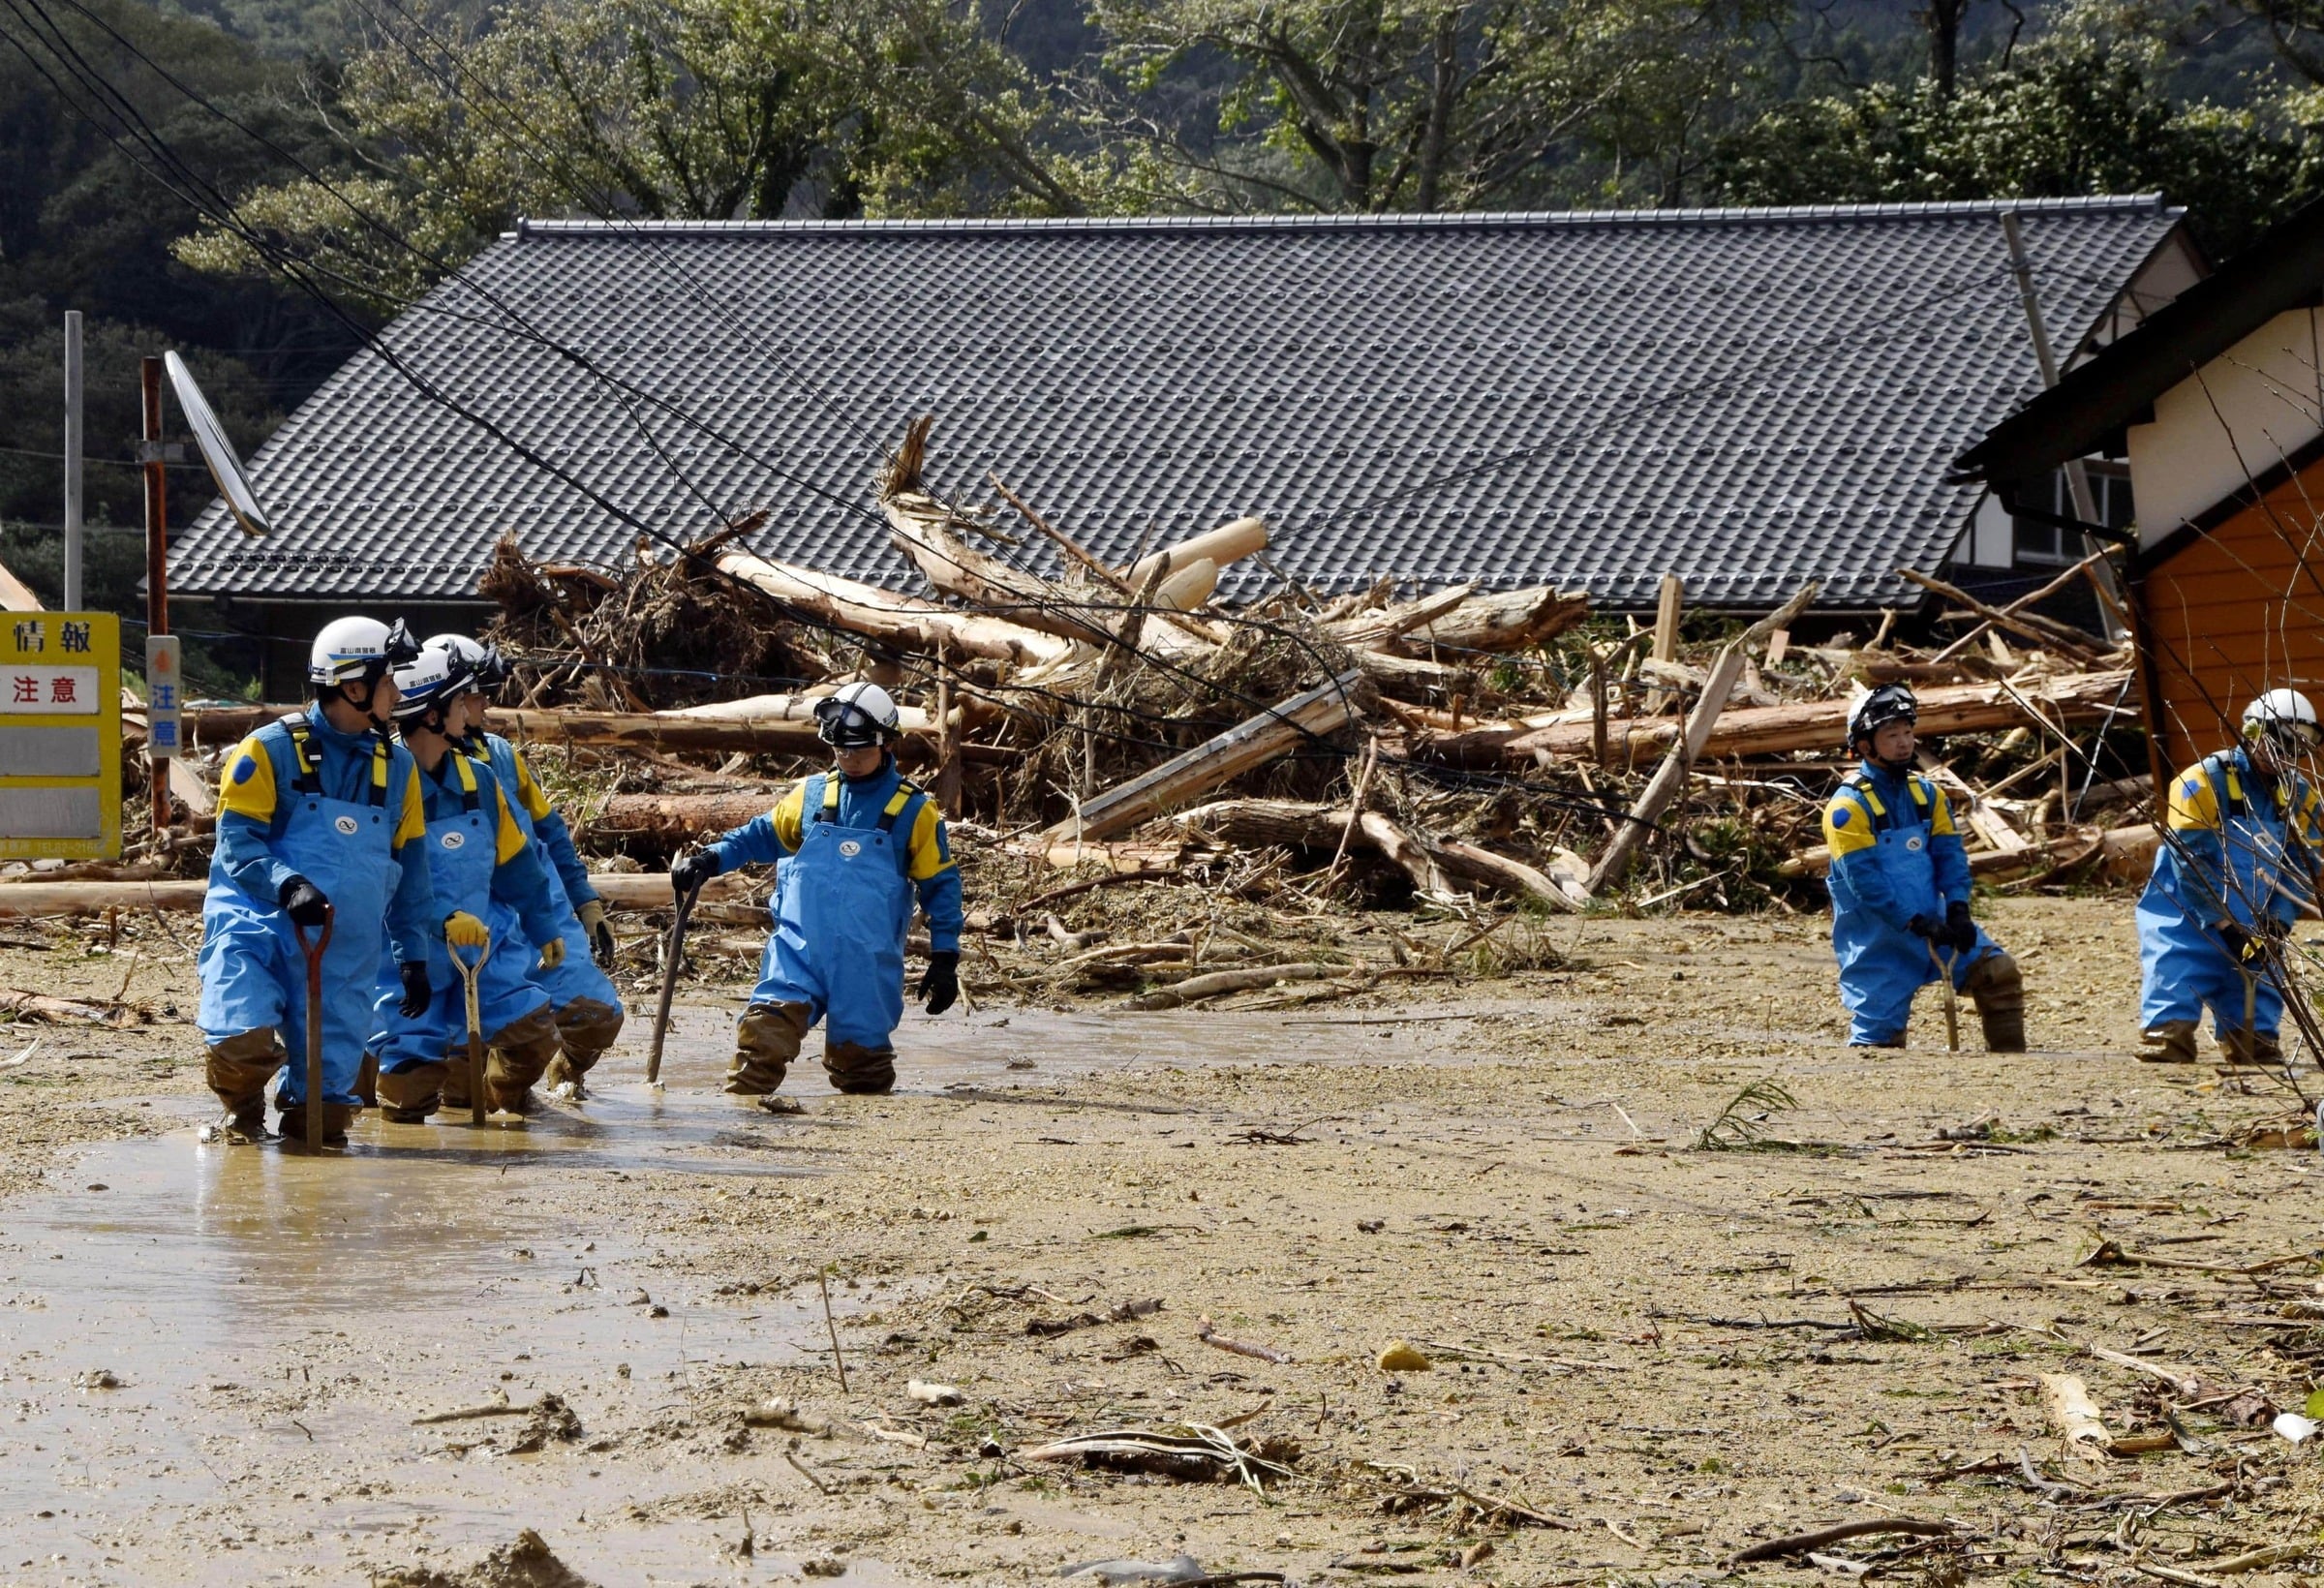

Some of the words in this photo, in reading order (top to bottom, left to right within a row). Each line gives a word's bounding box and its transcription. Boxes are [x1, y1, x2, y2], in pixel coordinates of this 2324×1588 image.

[14, 621, 90, 652] 情報
[13, 676, 76, 703] 注意
[152, 684, 176, 747] 注意
